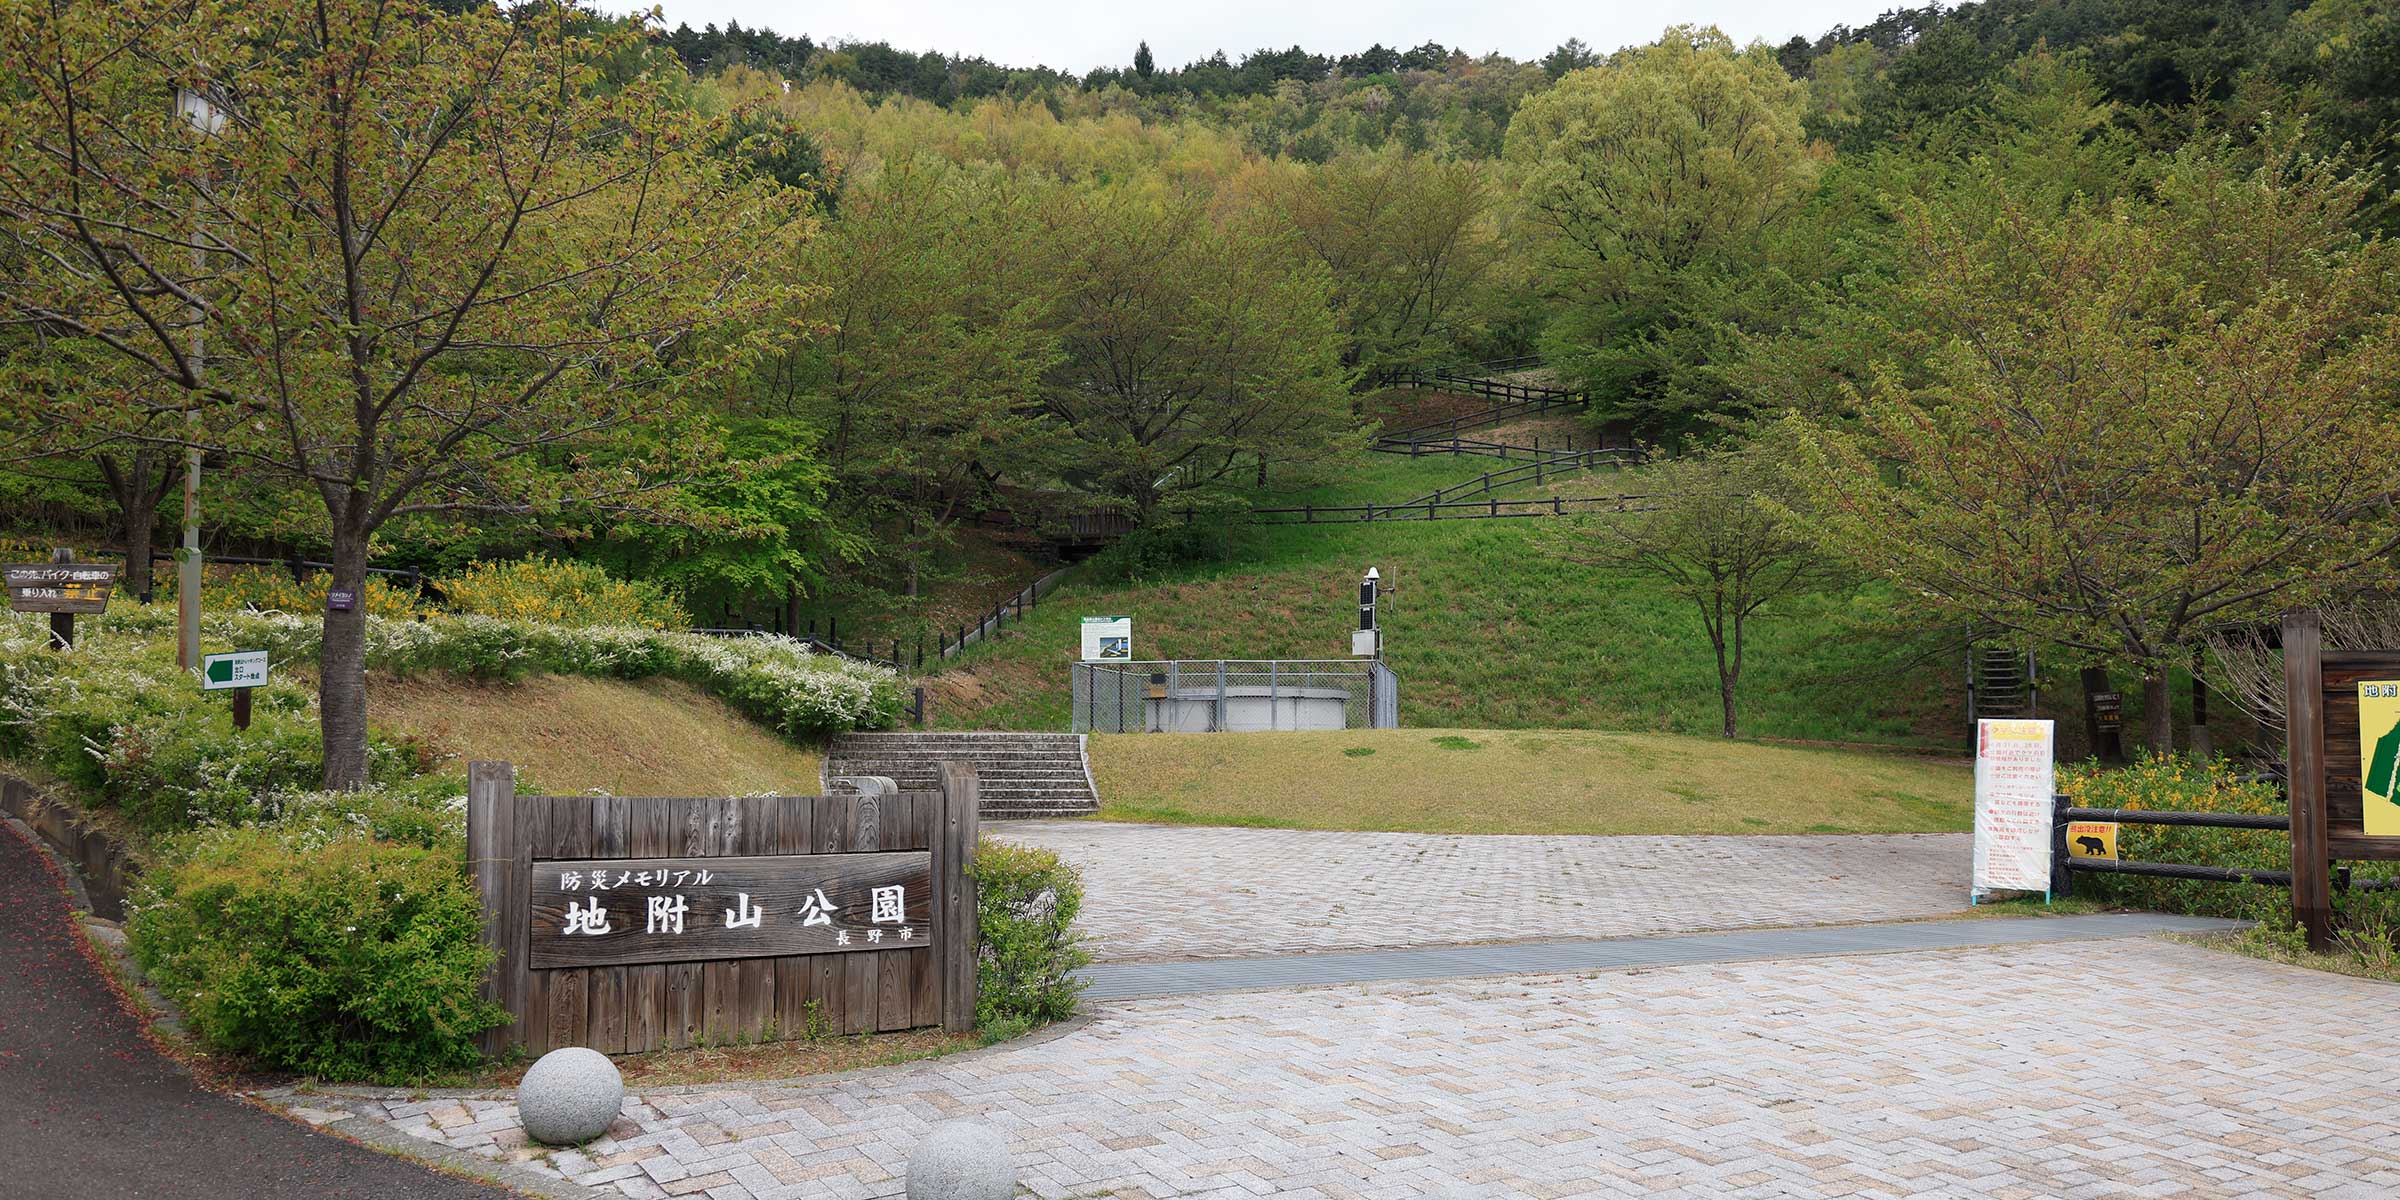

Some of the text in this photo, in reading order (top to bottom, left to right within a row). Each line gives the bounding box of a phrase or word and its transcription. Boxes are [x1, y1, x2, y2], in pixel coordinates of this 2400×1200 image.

[22, 583, 106, 600] 乗り入れ 禁止
[2364, 684, 2398, 698] 地附
[561, 868, 715, 892] 防災メモリアル
[563, 885, 905, 936] 地附山公園
[835, 926, 914, 946] 長野市
